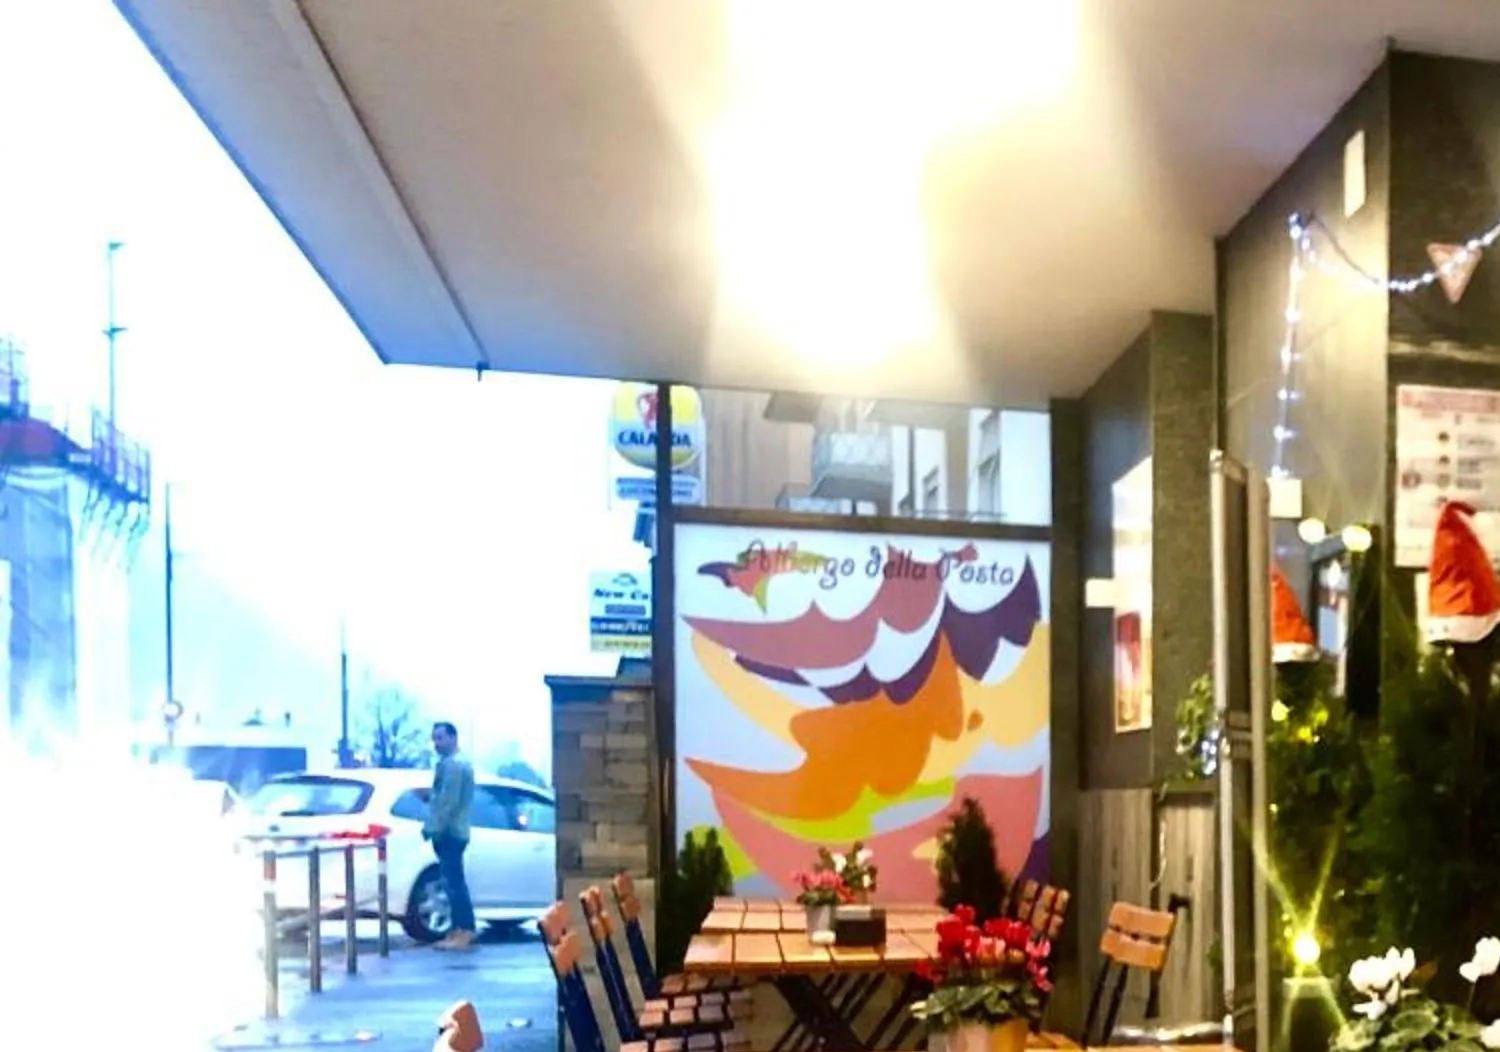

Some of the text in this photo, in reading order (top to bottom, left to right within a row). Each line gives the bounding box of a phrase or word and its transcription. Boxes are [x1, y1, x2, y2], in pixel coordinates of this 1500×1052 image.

[617, 431, 692, 447] CALADA
[740, 538, 1014, 590] Albergo della Posta
